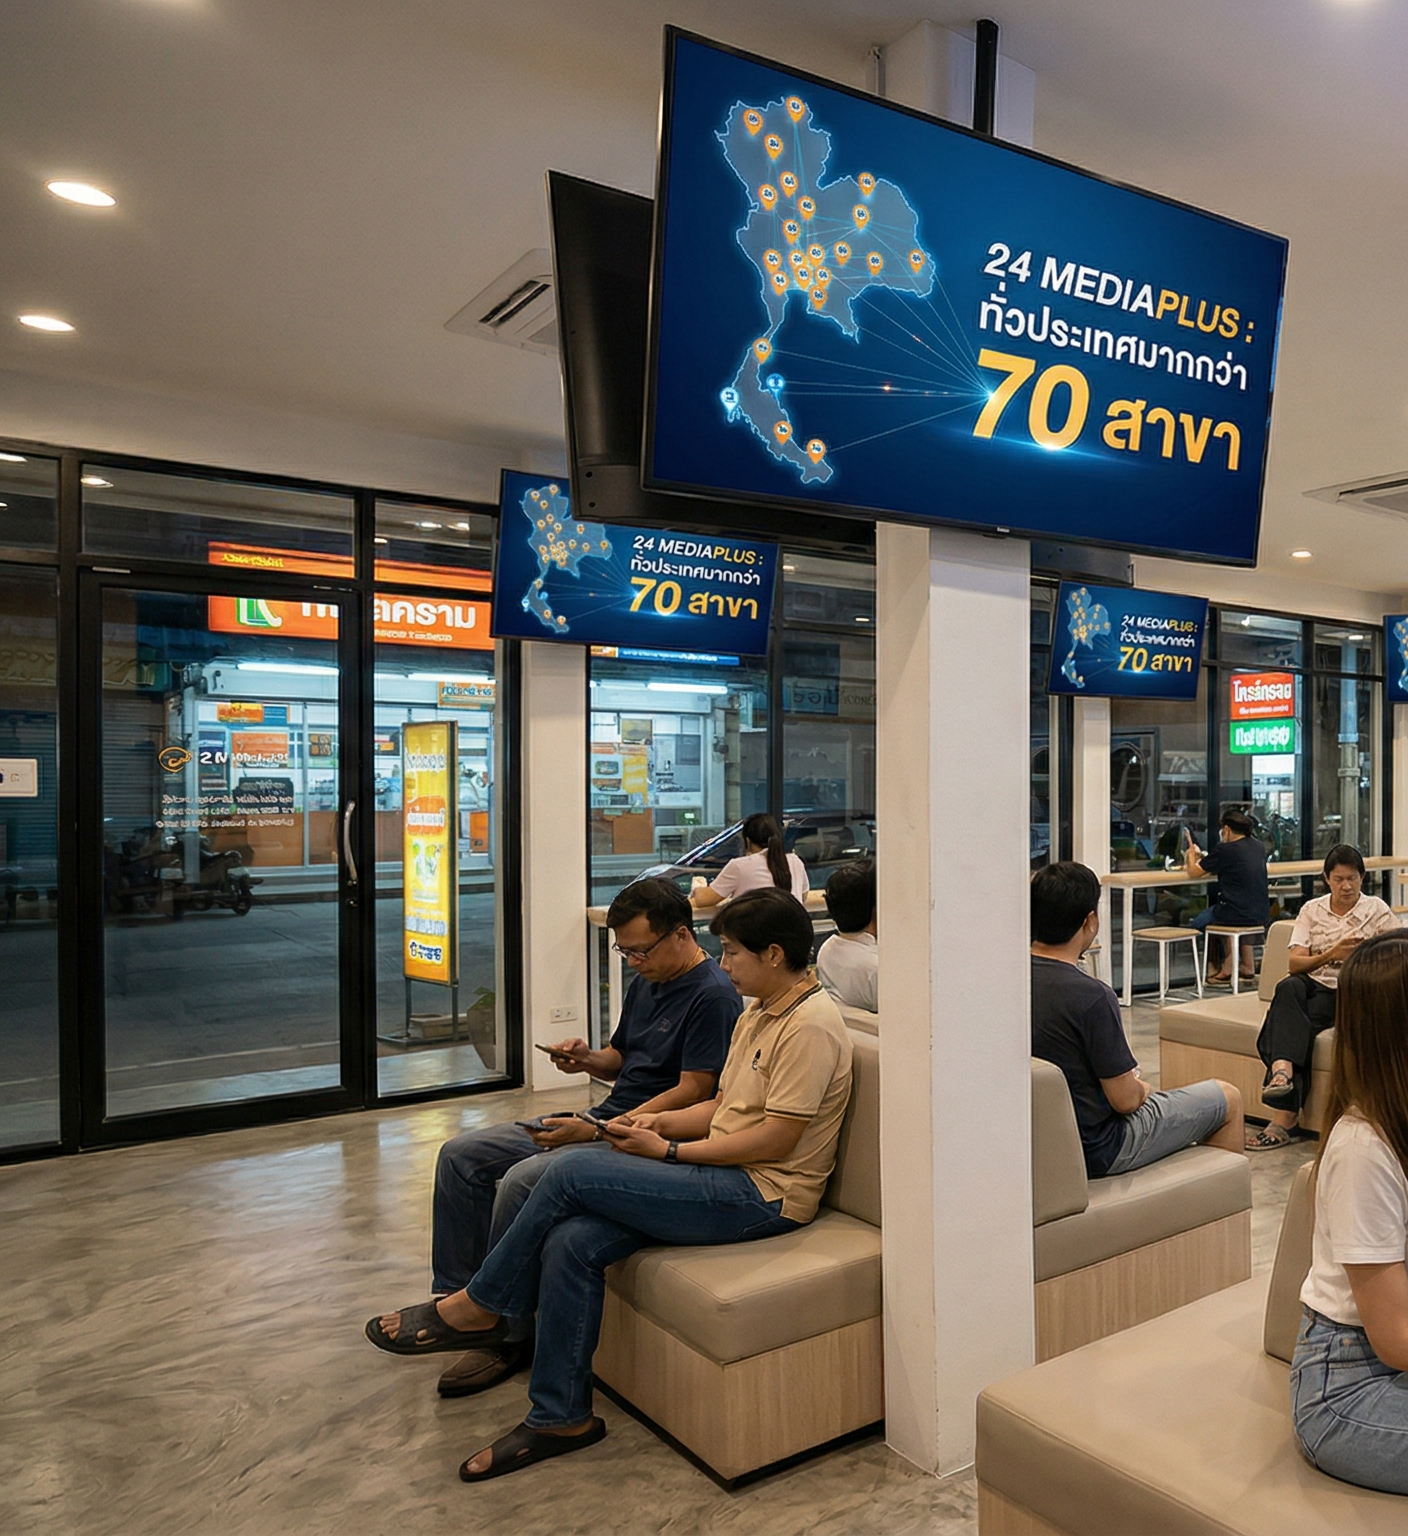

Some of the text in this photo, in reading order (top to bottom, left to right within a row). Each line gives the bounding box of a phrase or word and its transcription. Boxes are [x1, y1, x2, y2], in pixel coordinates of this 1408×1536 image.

[983, 242, 1032, 283] 24
[979, 281, 1248, 391] ทั่วประเทศมากกว่า
[972, 348, 1241, 471] 70 สาขา
[632, 535, 654, 551] 24
[629, 576, 758, 620] 70 สาขา
[1117, 646, 1193, 673] 70 สาขา
